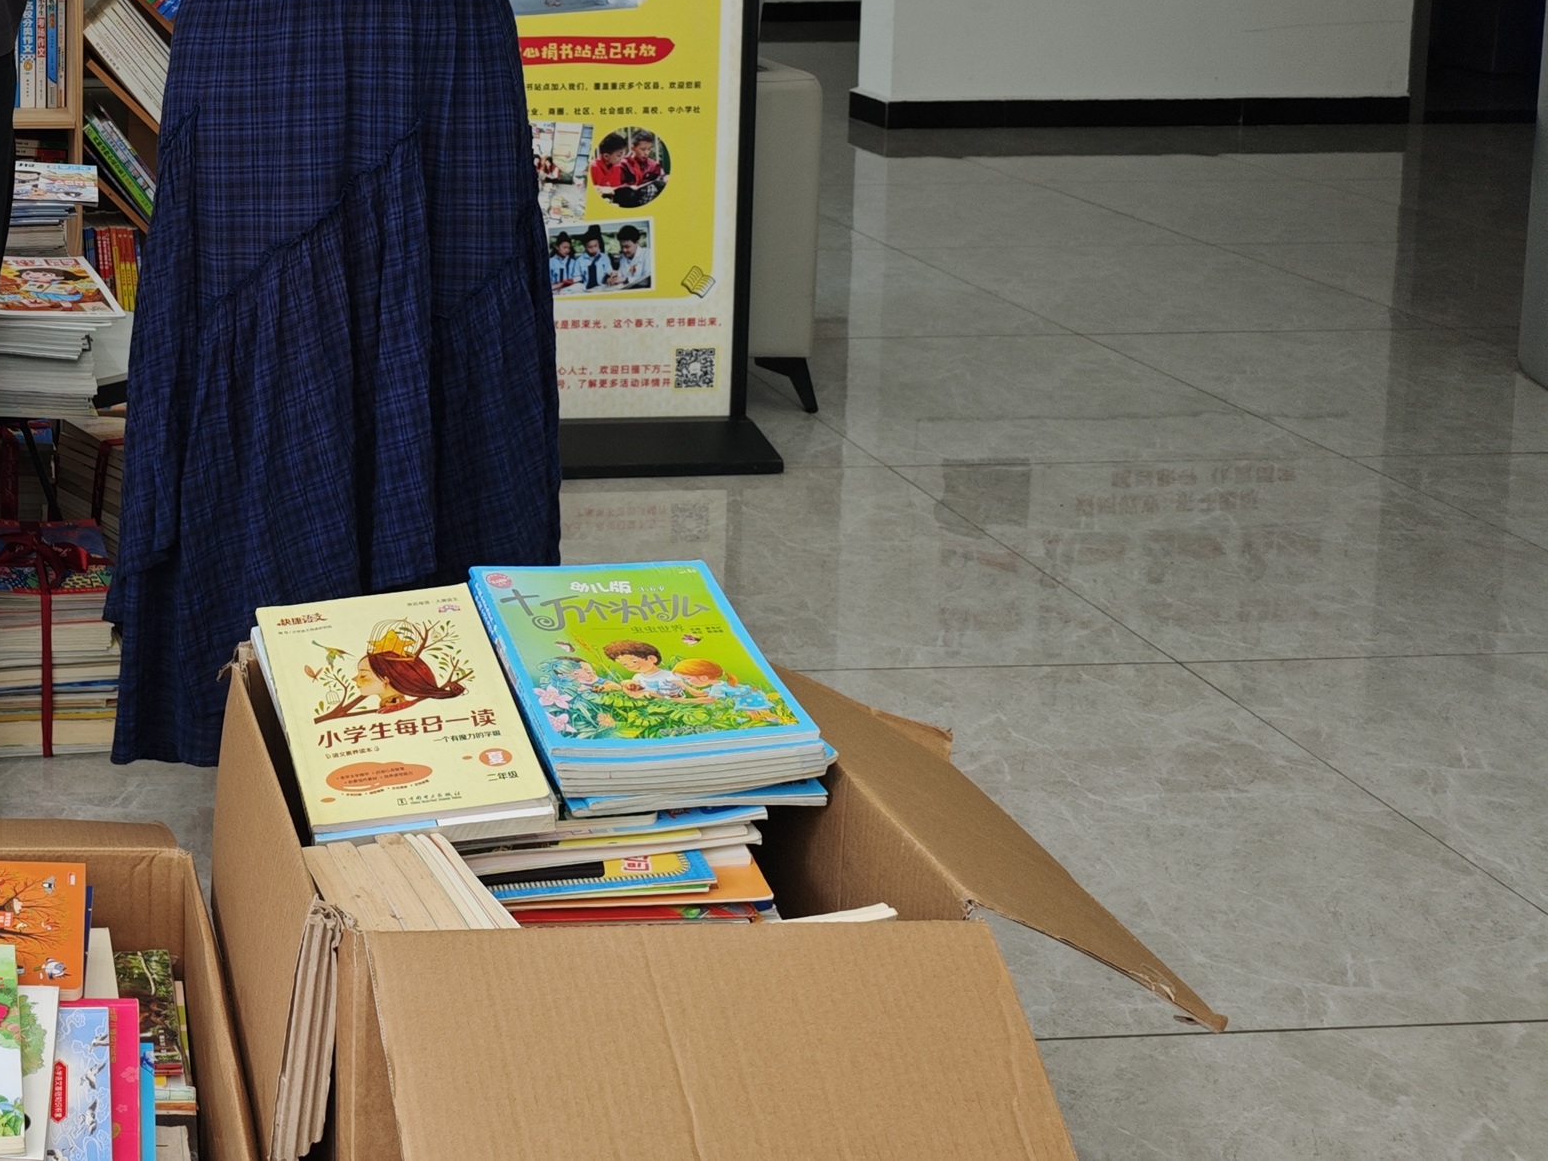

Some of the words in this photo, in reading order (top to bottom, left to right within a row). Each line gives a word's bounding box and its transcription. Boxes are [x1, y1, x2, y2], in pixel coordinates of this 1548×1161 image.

[523, 42, 657, 60] 心捐书站点已开放
[570, 580, 632, 594] 幼儿版
[499, 588, 711, 632] 十万个为什么
[631, 624, 685, 635] 虫虫世界
[318, 708, 498, 749] 小学生每日一读
[487, 771, 520, 782] 二年级
